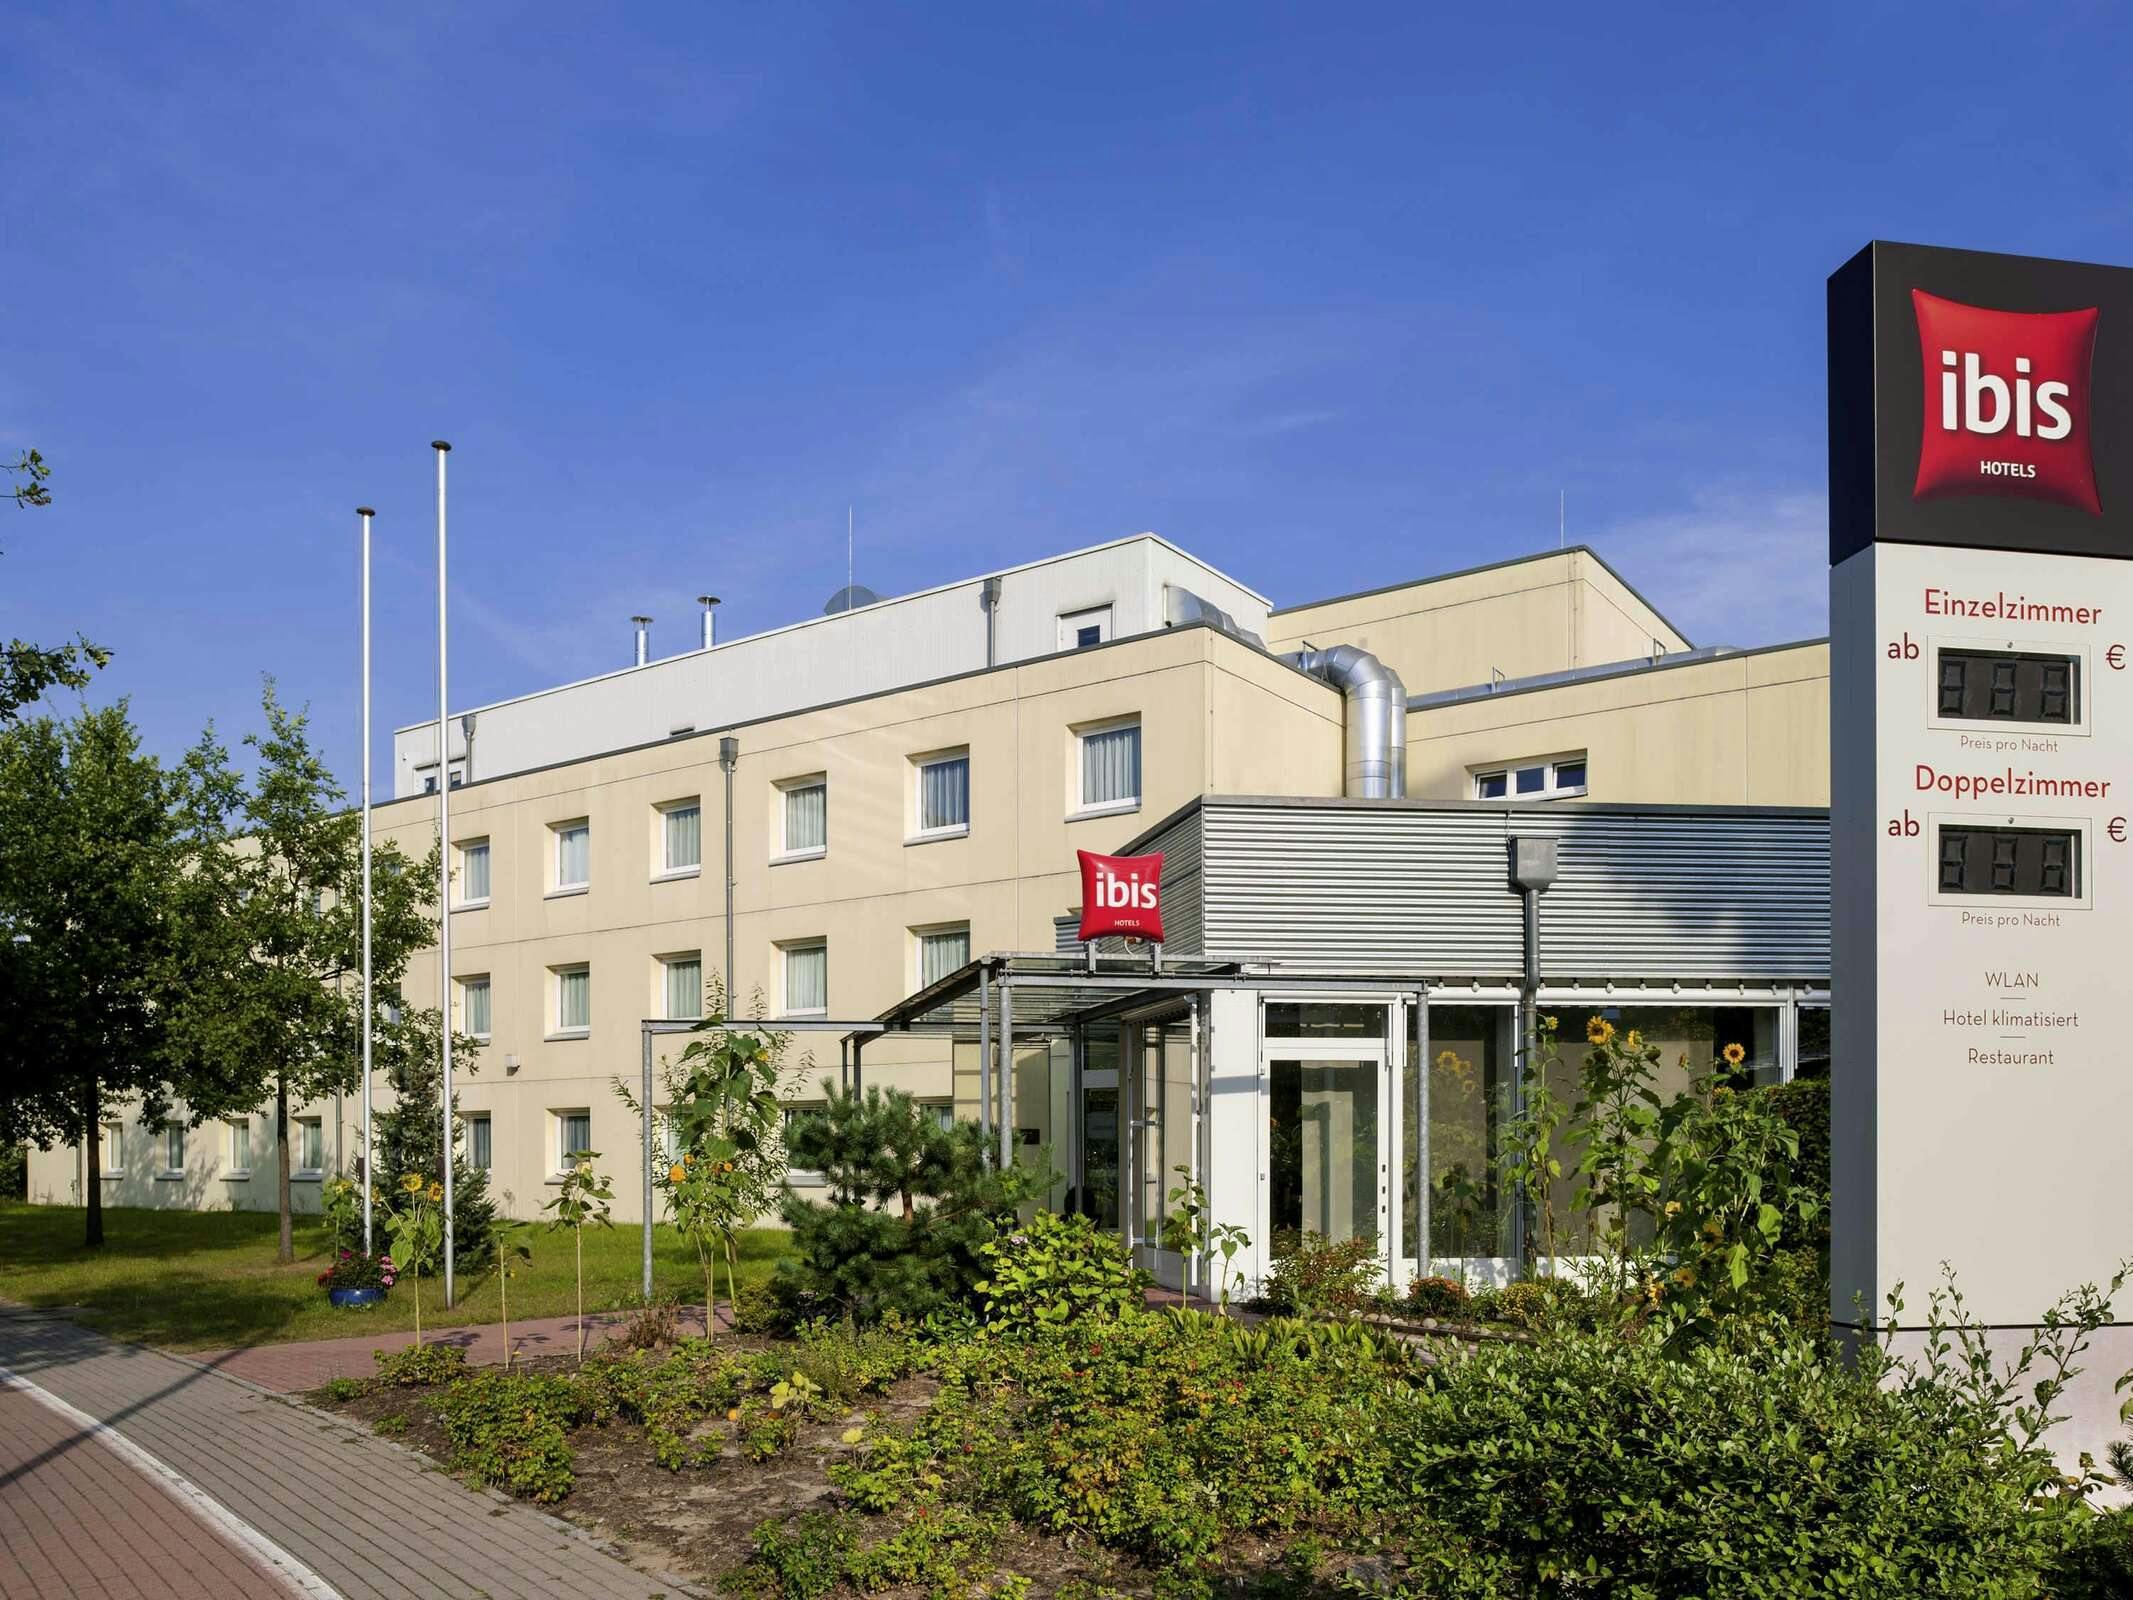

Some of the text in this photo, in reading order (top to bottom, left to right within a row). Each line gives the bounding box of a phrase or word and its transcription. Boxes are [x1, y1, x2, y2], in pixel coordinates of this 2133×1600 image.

[1942, 350, 2072, 440] ibis
[1980, 460, 2036, 478] HOTELS
[1925, 588, 2102, 625] Einzelzimmer
[1887, 631, 2127, 671] ab €
[1960, 735, 2059, 753] Preis pro Nacht
[1916, 764, 2111, 801] Doppelzimmer
[1888, 809, 2128, 843] ab €
[1096, 872, 1157, 909] ibis
[1114, 919, 1140, 927] HOTELS
[1961, 911, 2060, 928] Preis pro Nacht
[1985, 971, 2039, 988] WLAN
[1943, 1009, 2080, 1027] Hotel klimatisiert
[1968, 1048, 2055, 1065] Restaurant
